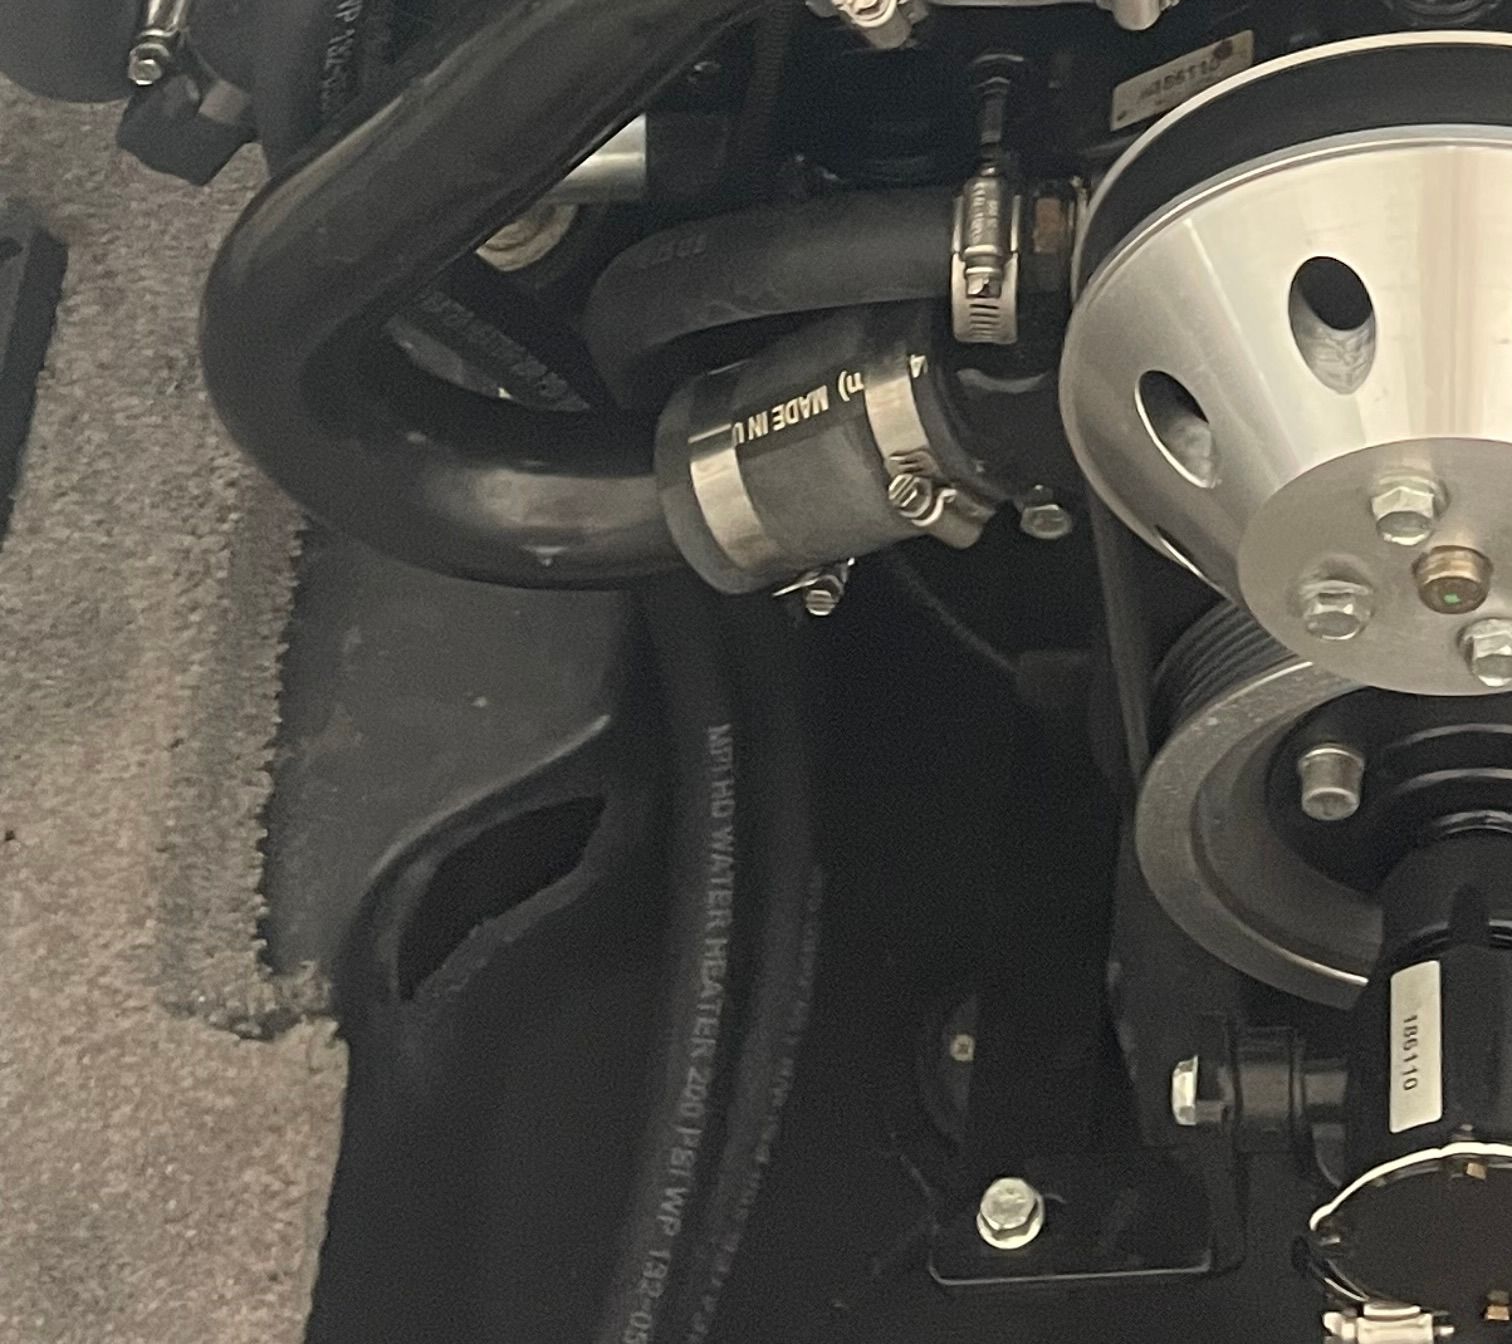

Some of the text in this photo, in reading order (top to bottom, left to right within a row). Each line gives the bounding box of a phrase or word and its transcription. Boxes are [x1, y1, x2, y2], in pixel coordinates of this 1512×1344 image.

[748, 421, 769, 441] IN
[772, 385, 830, 431] MADE
[710, 778, 736, 819] HD
[705, 825, 736, 931] WATER
[688, 938, 730, 1059] HEATER
[680, 1066, 711, 1119] 200
[655, 1185, 690, 1237] WP
